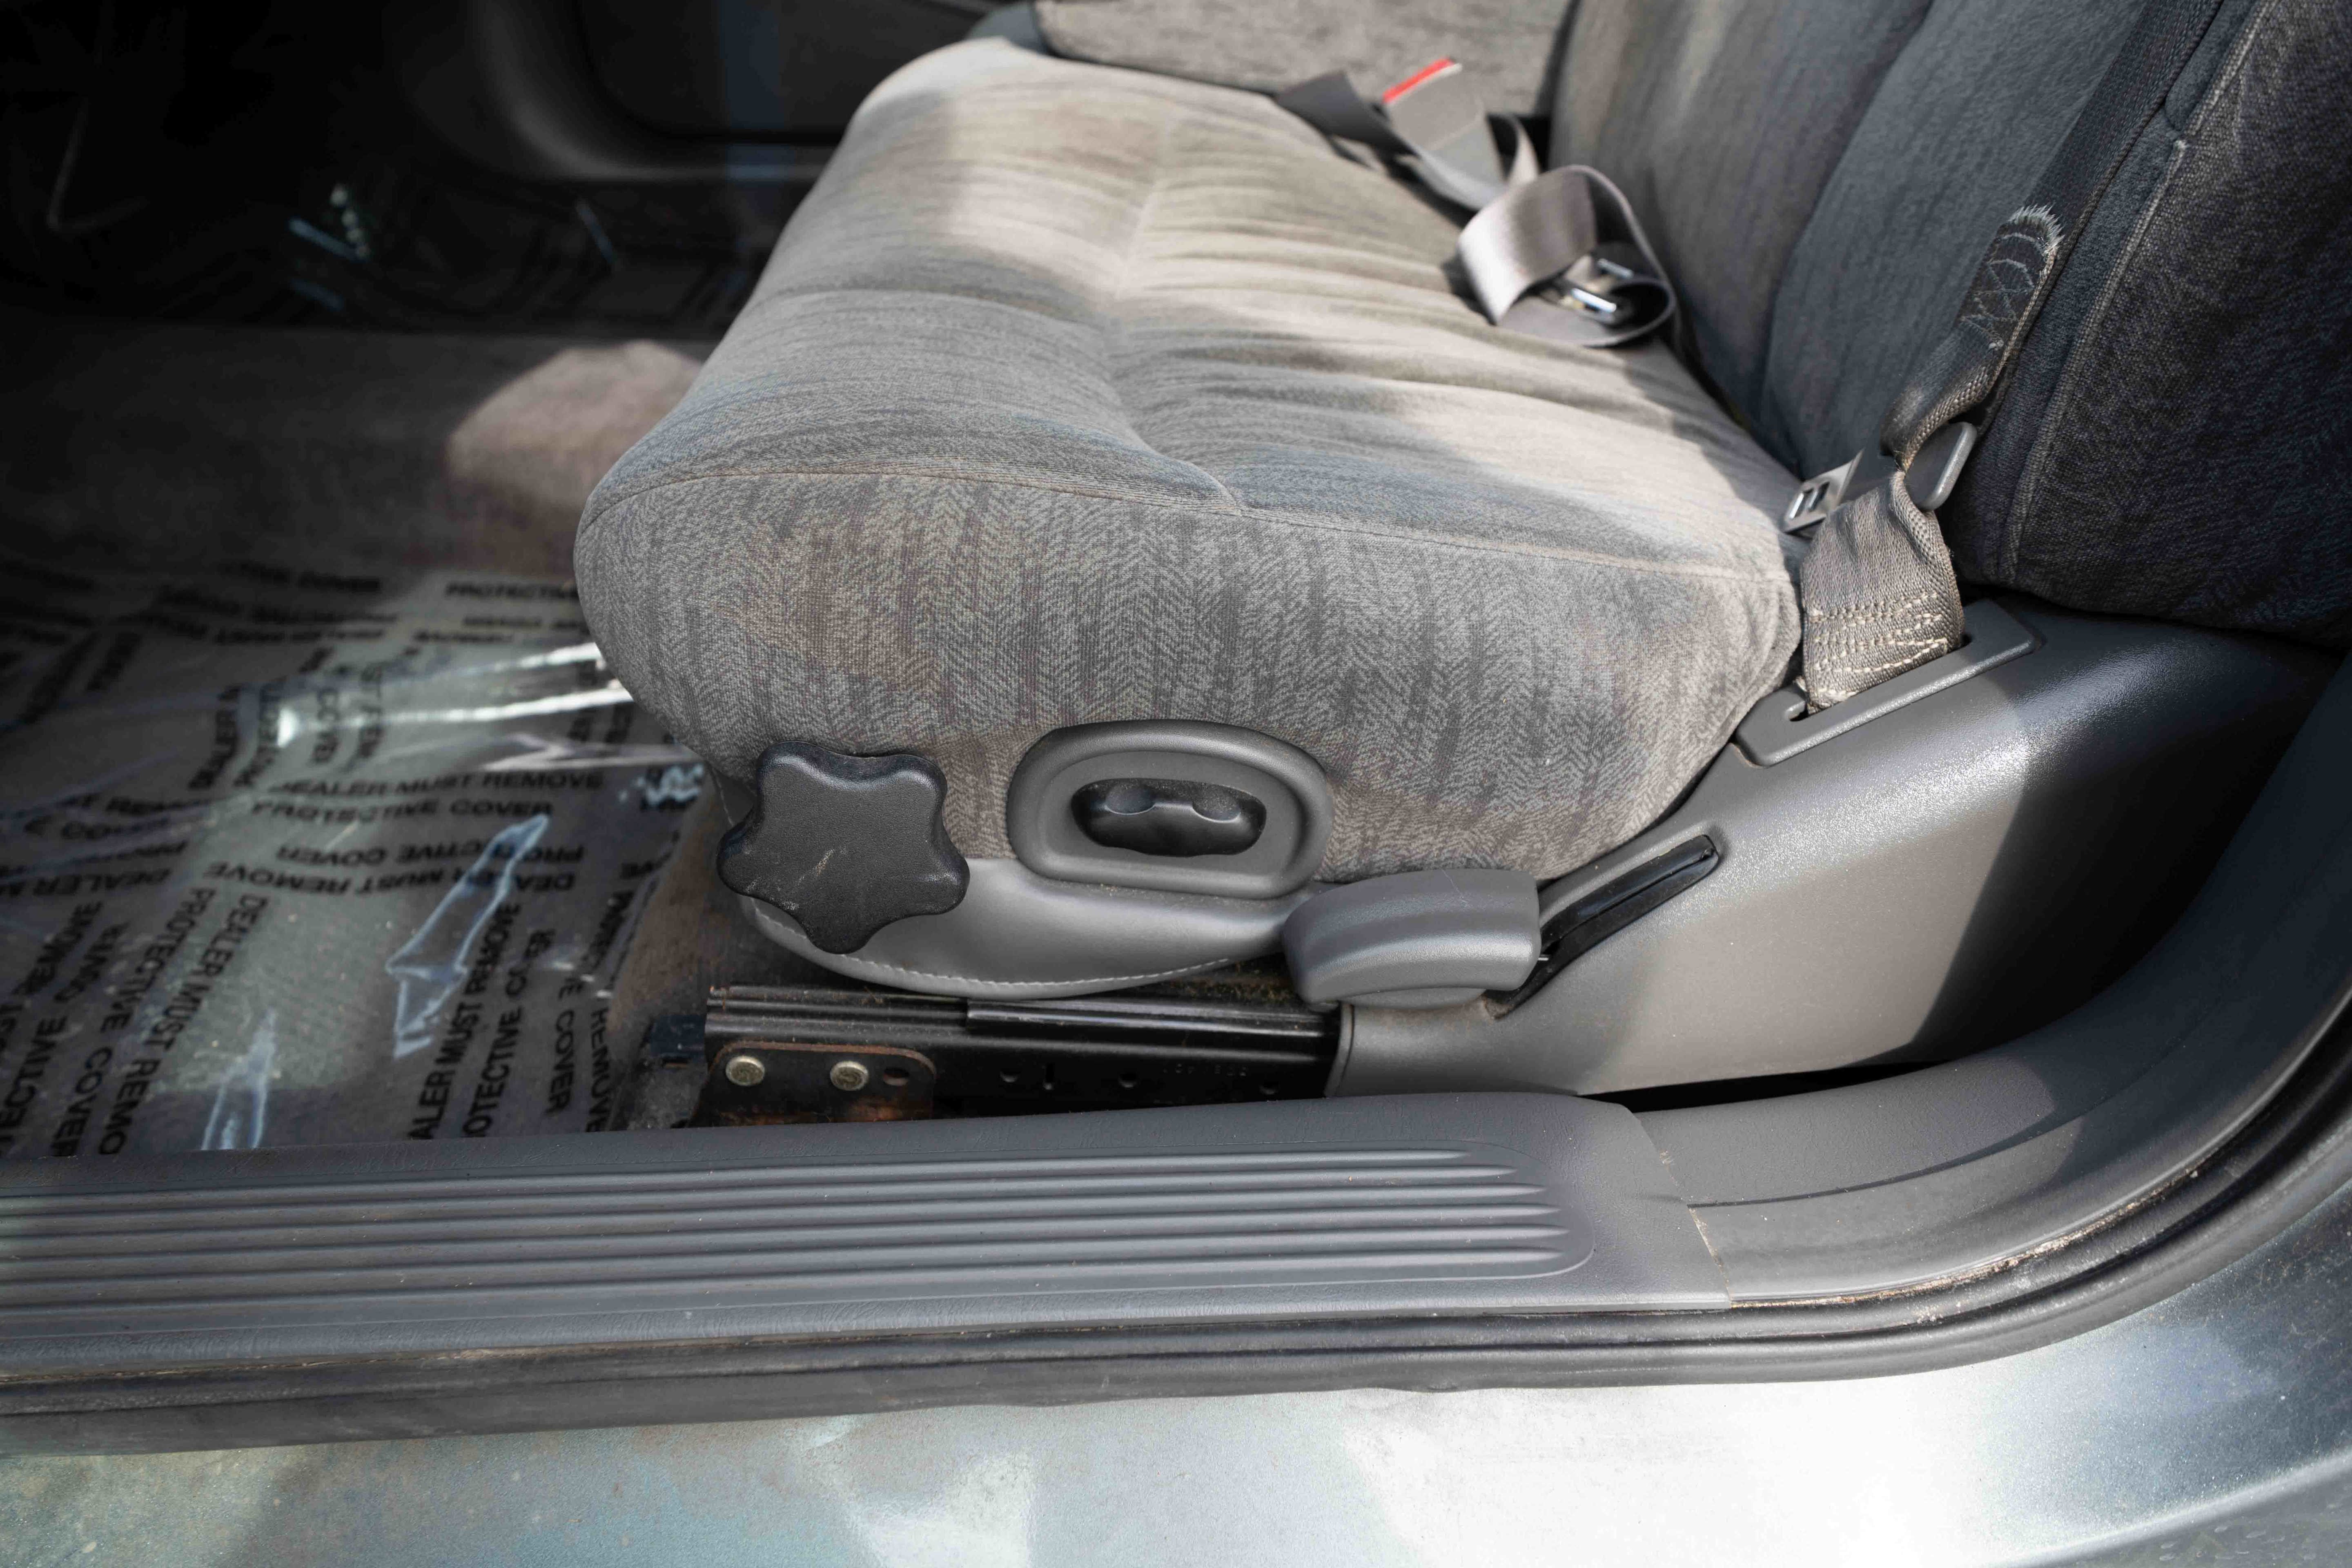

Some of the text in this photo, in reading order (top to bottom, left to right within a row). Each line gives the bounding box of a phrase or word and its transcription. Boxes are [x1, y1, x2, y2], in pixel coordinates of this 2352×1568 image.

[252, 798, 554, 822] PROTECTIVE COVER
[395, 773, 473, 793] MUST
[482, 770, 605, 791] REMOVE
[204, 860, 351, 896] REMOVE
[276, 844, 388, 866] COVER
[353, 867, 444, 895] MUST
[100, 887, 217, 1033] PROTECTIVE
[98, 893, 270, 1155] DEALER MUST REMO
[408, 901, 522, 1139] ALER MUST REMOVE
[462, 1006, 523, 1138] OTECTIVE
[541, 1009, 576, 1116] COVER
[49, 1047, 113, 1156] COVER
